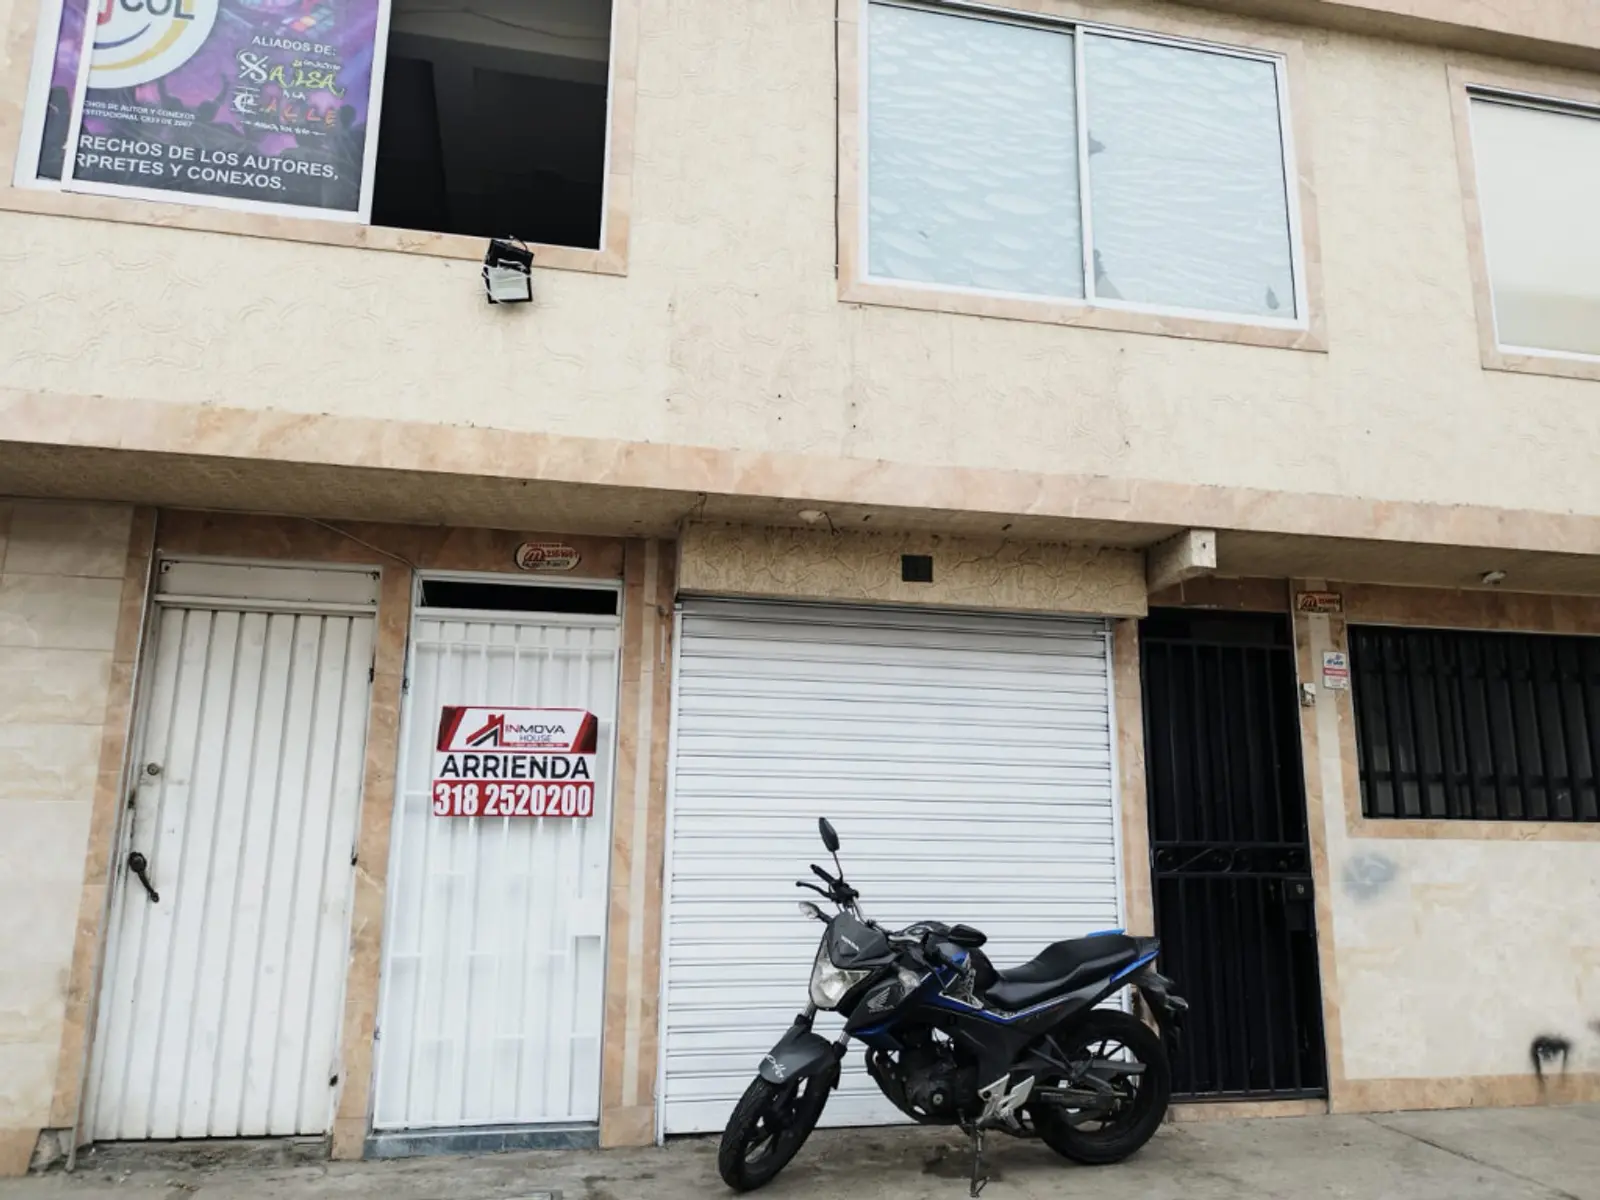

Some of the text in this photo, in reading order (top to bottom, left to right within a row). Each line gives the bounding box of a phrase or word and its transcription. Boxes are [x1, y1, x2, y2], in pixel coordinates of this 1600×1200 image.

[251, 35, 337, 56] ALIADOS DE:
[80, 134, 339, 180] RECHOS DE LOS AUTORES,
[169, 162, 183, 177] Y
[187, 165, 286, 190] CONEXOS.
[505, 724, 565, 734] INMOVA
[519, 734, 553, 742] HOUSE
[439, 754, 590, 779] ARRIENDA
[434, 782, 592, 816] 318 2520200
